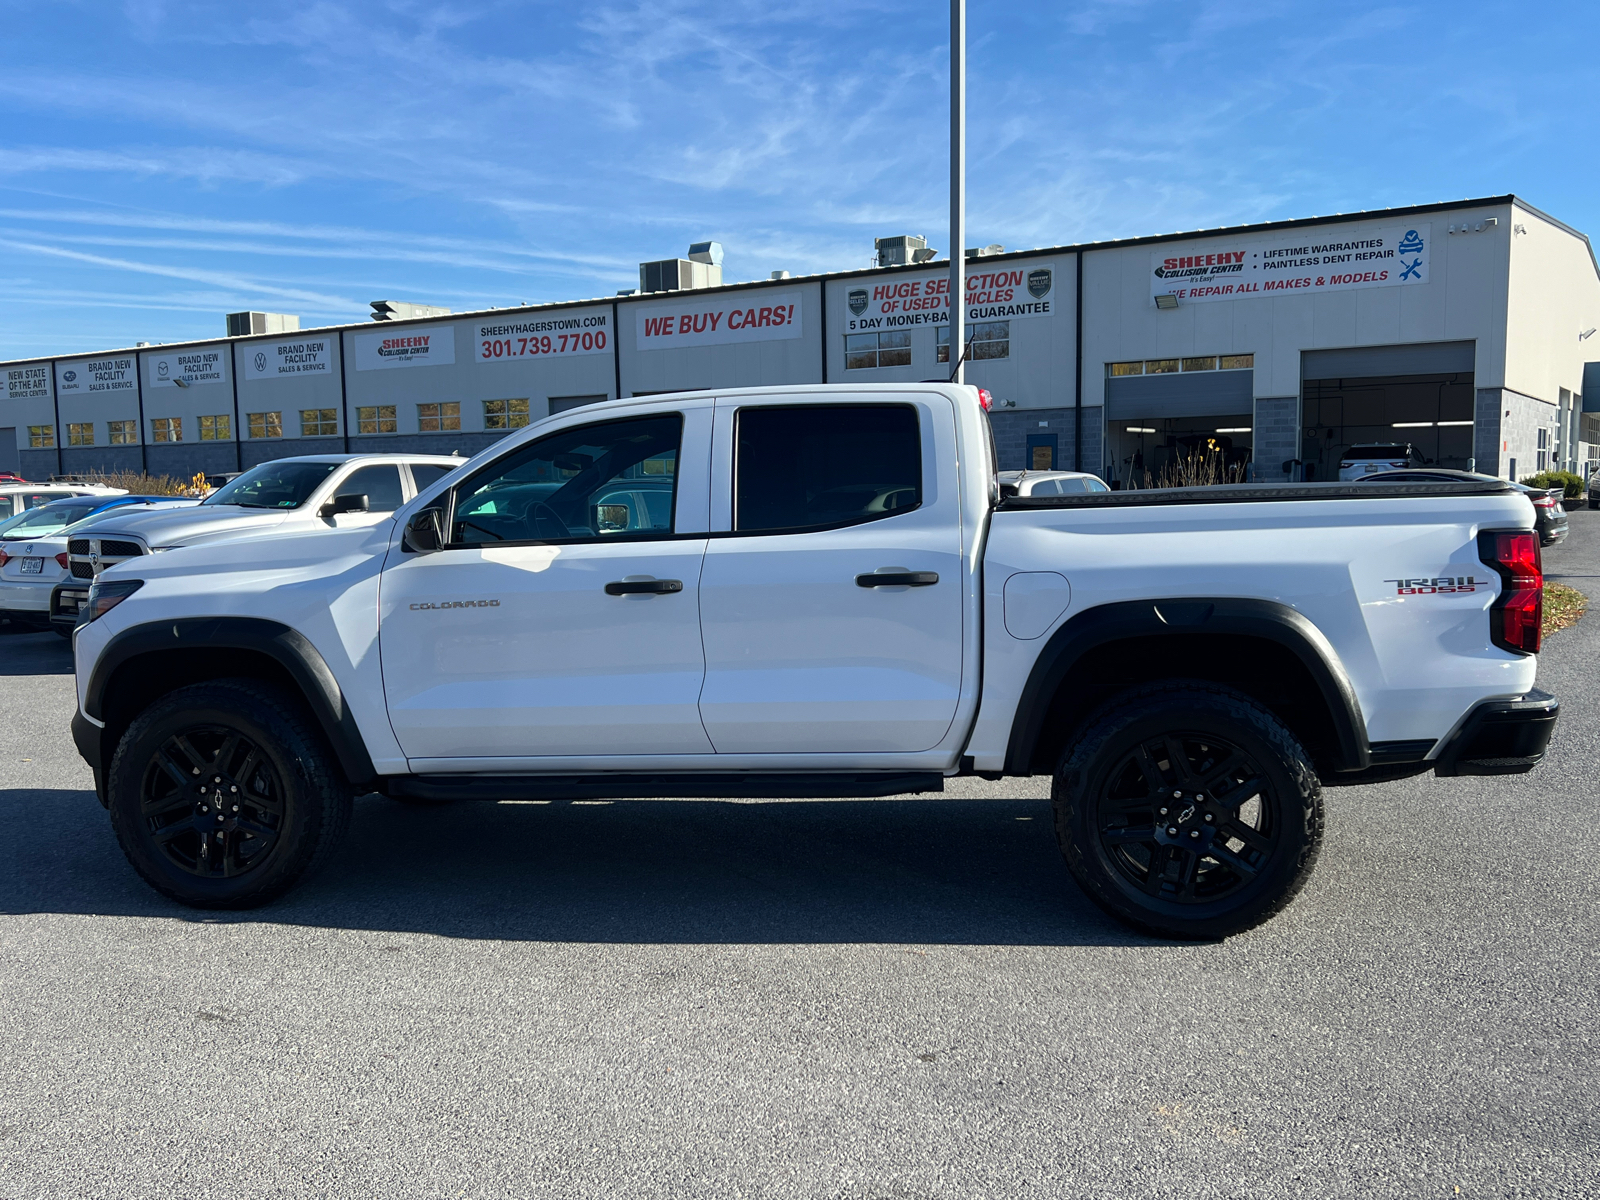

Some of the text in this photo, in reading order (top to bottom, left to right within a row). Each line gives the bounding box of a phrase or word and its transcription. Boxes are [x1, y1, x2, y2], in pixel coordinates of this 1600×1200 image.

[1263, 239, 1383, 259] LIFETIME WARRANTIES
[1163, 251, 1246, 270] SHEEHY
[1263, 250, 1394, 270] PAINTLESS DENT REPAIR
[1164, 263, 1244, 279] COLLISION CENTER
[873, 270, 1024, 300] HUGE SELCTION
[1189, 285, 1234, 298] REPAIR
[1236, 282, 1259, 294] ALL
[1263, 277, 1311, 291] MAKES
[1315, 276, 1325, 286] &
[1329, 270, 1388, 285] MODELS
[881, 288, 1014, 314] OF USED VHICLES
[645, 304, 794, 337] WE BUY CARS!
[849, 301, 1050, 330] 5 DAY MONEY-BA GUARANTEE
[481, 316, 606, 337] SHEEHYHAGERSTOWN.COM
[382, 336, 430, 349] SHEEHY
[481, 330, 607, 359] 301.739.7700
[277, 343, 324, 356] BRAND NEW
[410, 346, 429, 355] CENTER
[178, 353, 218, 365] BRAND NEW
[285, 353, 317, 364] FACILITY
[88, 360, 131, 372] BRAND NEW
[184, 363, 213, 374] FACILITY
[278, 365, 295, 373] SALES
[302, 363, 326, 371] SERVICE
[8, 368, 46, 380] NEW STATE
[95, 370, 125, 381] FACILITY
[9, 379, 46, 391] OF THE ART
[89, 381, 133, 391] SALES & SERVICE
[9, 389, 47, 398] SERVICE CENTER
[1383, 576, 1488, 588] TRAIL
[1397, 585, 1475, 595] BOSS
[409, 599, 501, 611] COLORADO
